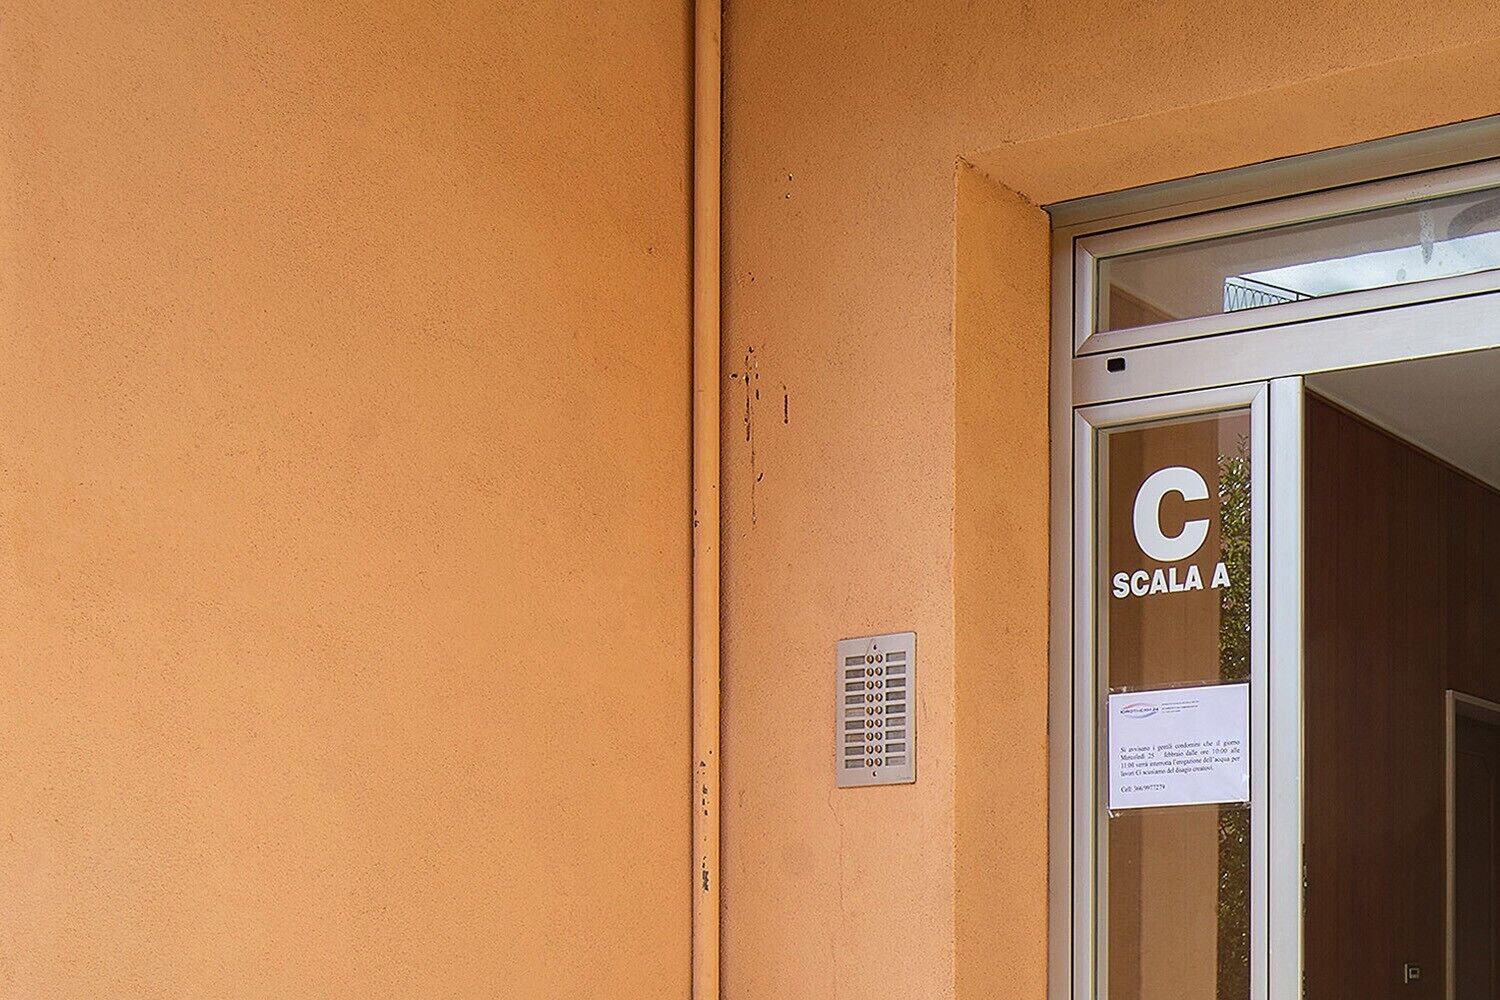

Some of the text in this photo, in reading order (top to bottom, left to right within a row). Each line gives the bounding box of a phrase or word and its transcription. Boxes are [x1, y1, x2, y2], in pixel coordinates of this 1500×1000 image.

[1133, 466, 1210, 562] C
[1112, 562, 1231, 599] SCALA A
